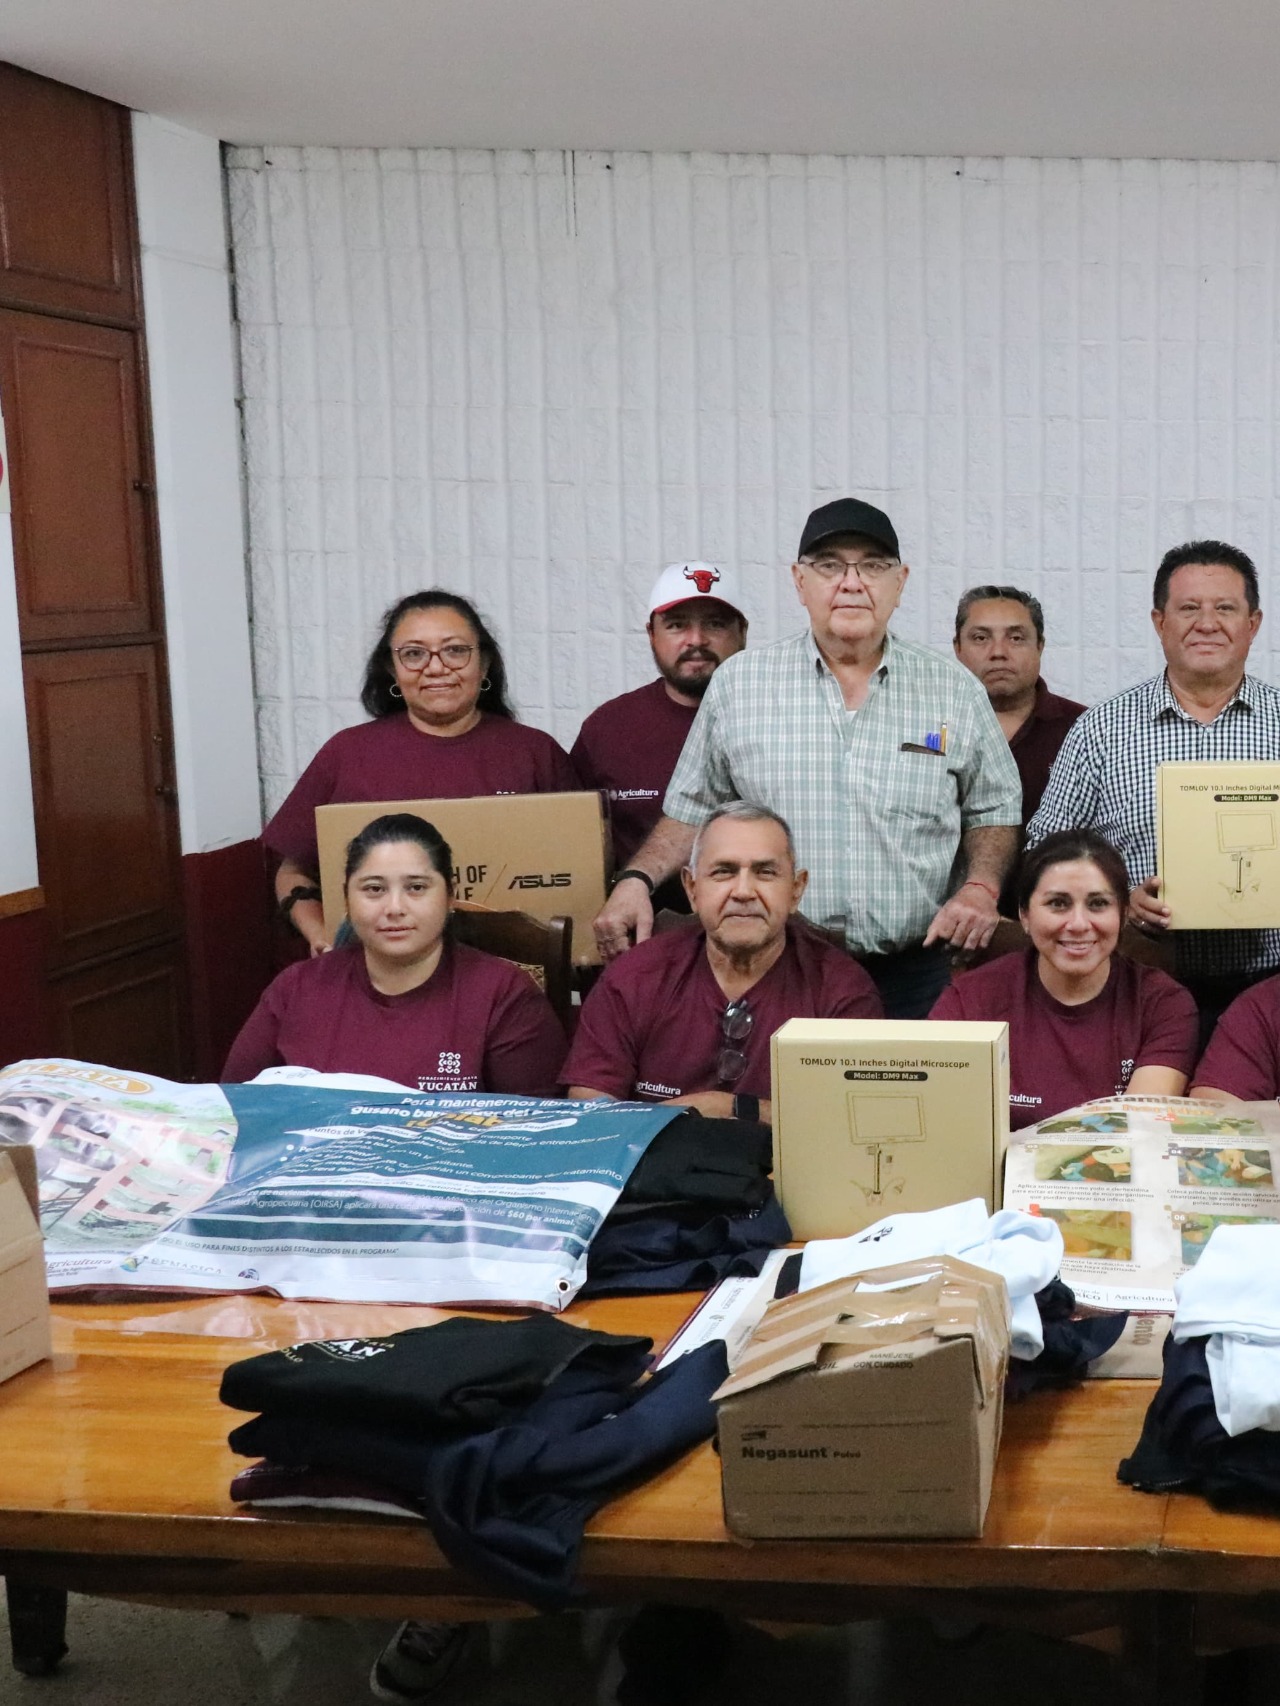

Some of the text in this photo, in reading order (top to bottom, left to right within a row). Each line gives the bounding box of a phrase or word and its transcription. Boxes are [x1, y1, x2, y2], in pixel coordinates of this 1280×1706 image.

[618, 788, 659, 797] Agricultura
[1249, 784, 1272, 792] Digital
[466, 865, 487, 883] OF
[508, 873, 571, 889] ASUS
[800, 1057, 970, 1069] TOMLOV 10.1 Inches Digital Microscope
[418, 1080, 478, 1091] YUCATÁN
[401, 1096, 537, 1108] Para mantenernos
[1009, 1094, 1042, 1104] cultura
[351, 1105, 411, 1117] gusano
[479, 1197, 495, 1206] del
[495, 1199, 544, 1213] Organismo
[507, 1210, 525, 1219] $60
[525, 1213, 542, 1223] por
[542, 1215, 577, 1227] animal.
[202, 1243, 220, 1251] PARA
[221, 1244, 241, 1252] FINES
[293, 1245, 341, 1255] ESTABLECIDOS
[1114, 1293, 1173, 1303] Agricultura
[853, 1361, 914, 1369] CON CUIDADO
[742, 1446, 828, 1461] Negasunt
